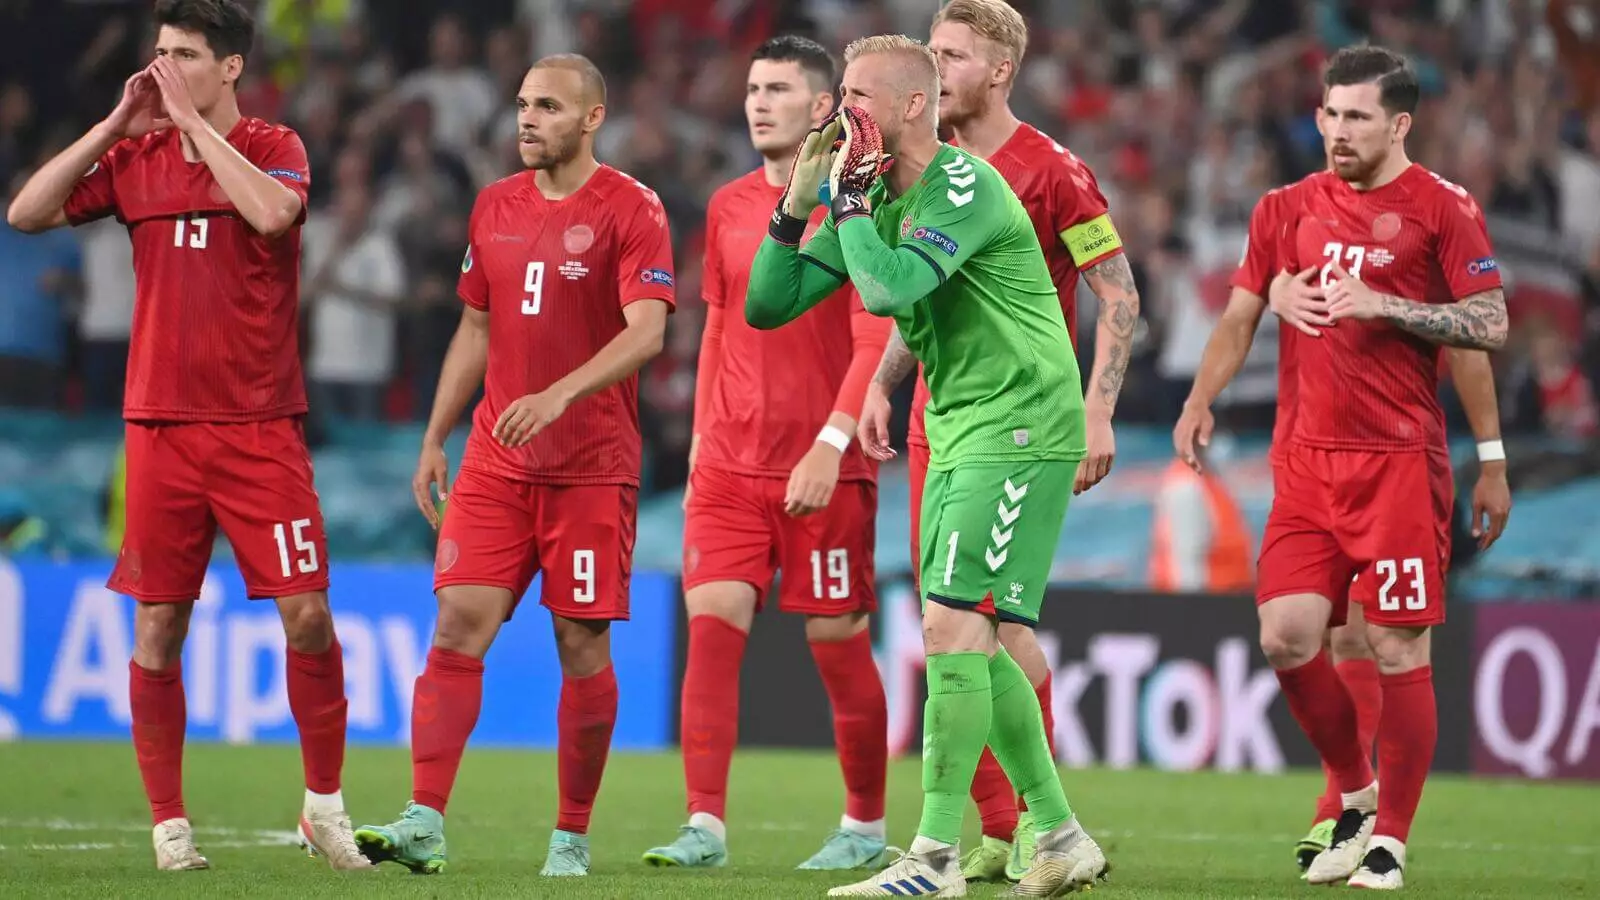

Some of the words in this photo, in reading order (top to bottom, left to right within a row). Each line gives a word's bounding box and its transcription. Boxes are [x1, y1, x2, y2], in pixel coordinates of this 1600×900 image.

[925, 231, 957, 253] RESPECT
[1083, 233, 1115, 252] RESPECT
[521, 261, 545, 315] 9
[274, 518, 319, 577] 15
[809, 548, 850, 600] 19
[943, 530, 960, 586] 1
[573, 549, 595, 603] 9
[1376, 557, 1427, 611] 23
[40, 573, 435, 747] Aipay
[1038, 632, 1288, 773] kTok
